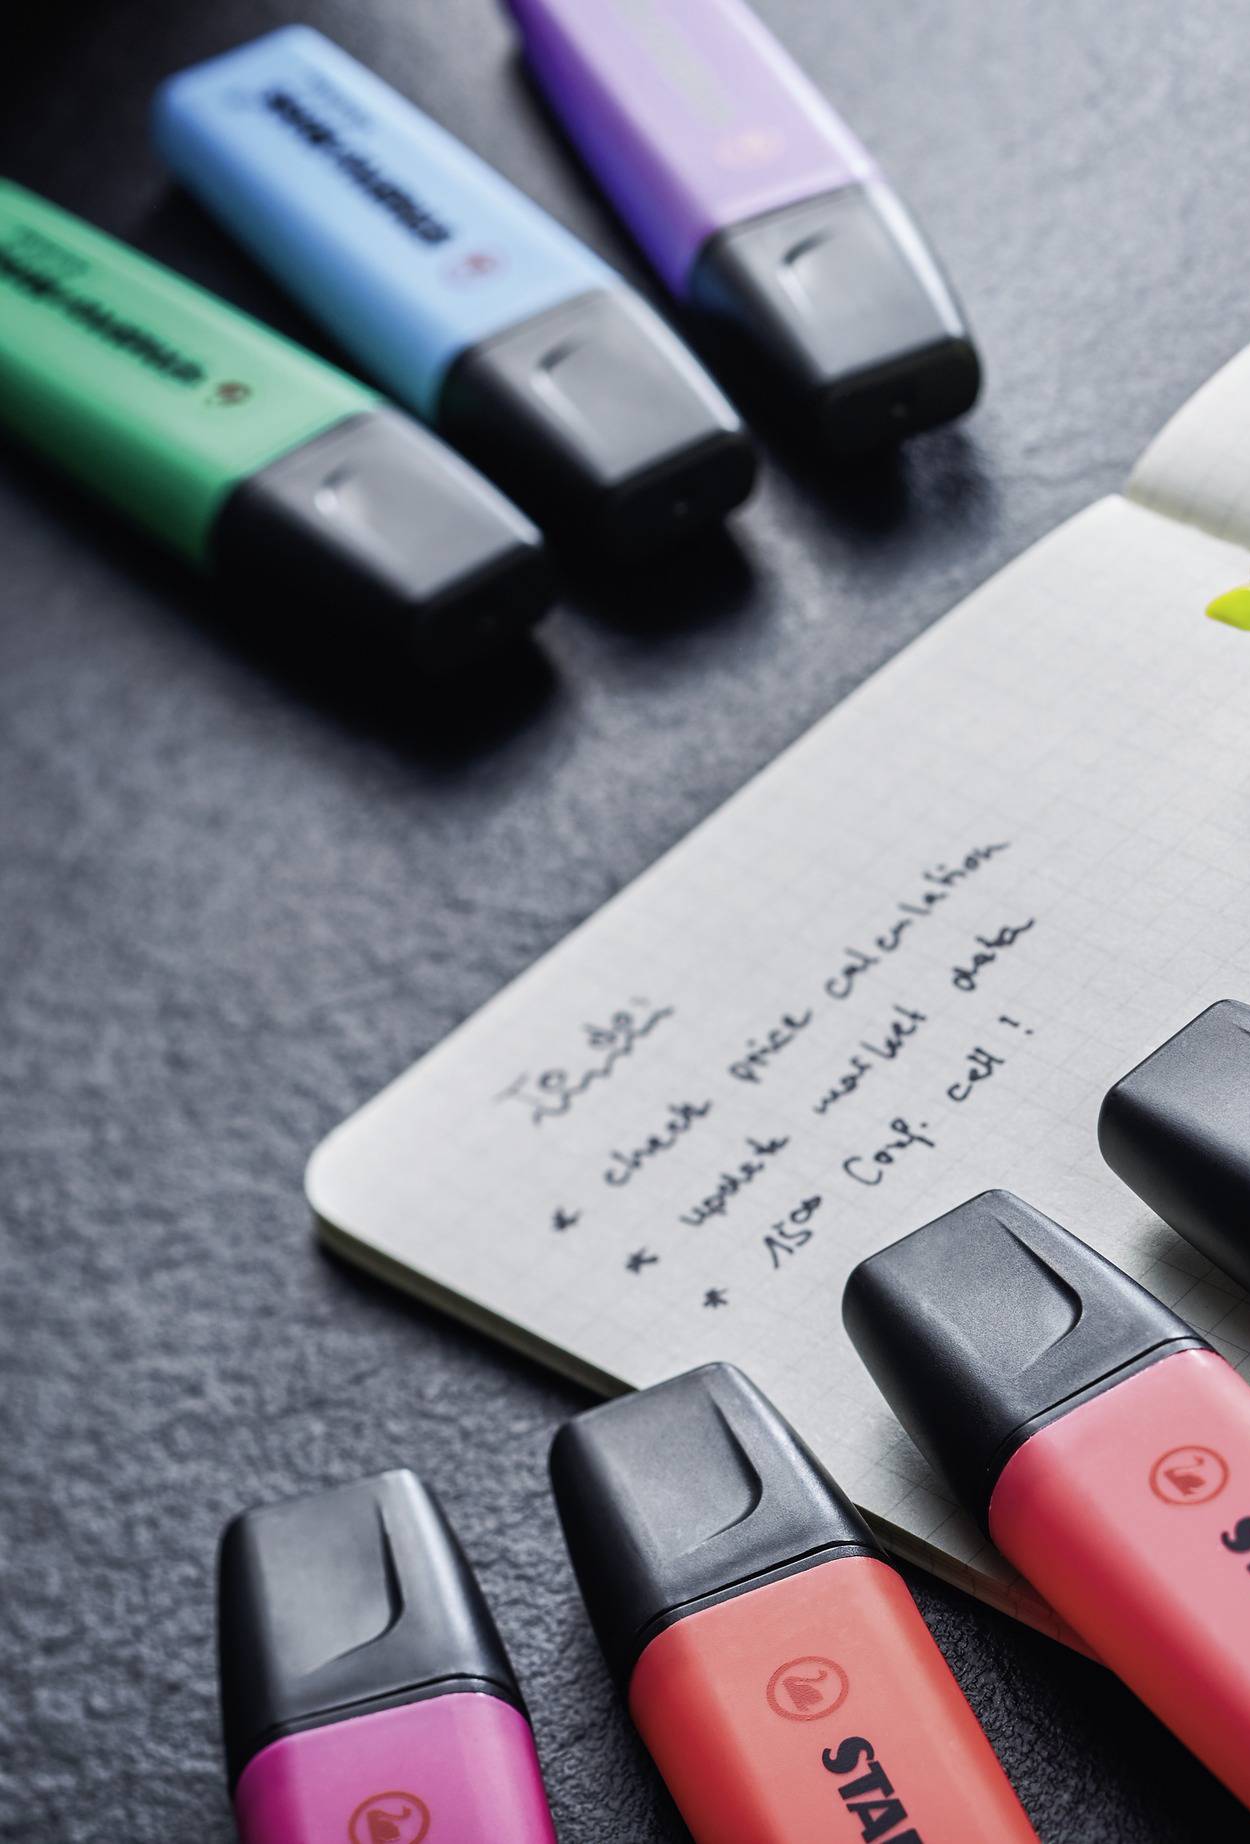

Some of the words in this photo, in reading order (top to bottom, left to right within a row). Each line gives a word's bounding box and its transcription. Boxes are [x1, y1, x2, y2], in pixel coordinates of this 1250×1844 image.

[603, 1099, 712, 1187] check
[729, 1008, 813, 1085] price
[825, 841, 1010, 999] calculation
[681, 1133, 790, 1228] update
[813, 1005, 927, 1114] market
[953, 917, 1035, 991] data
[822, 1736, 924, 1844] STA
